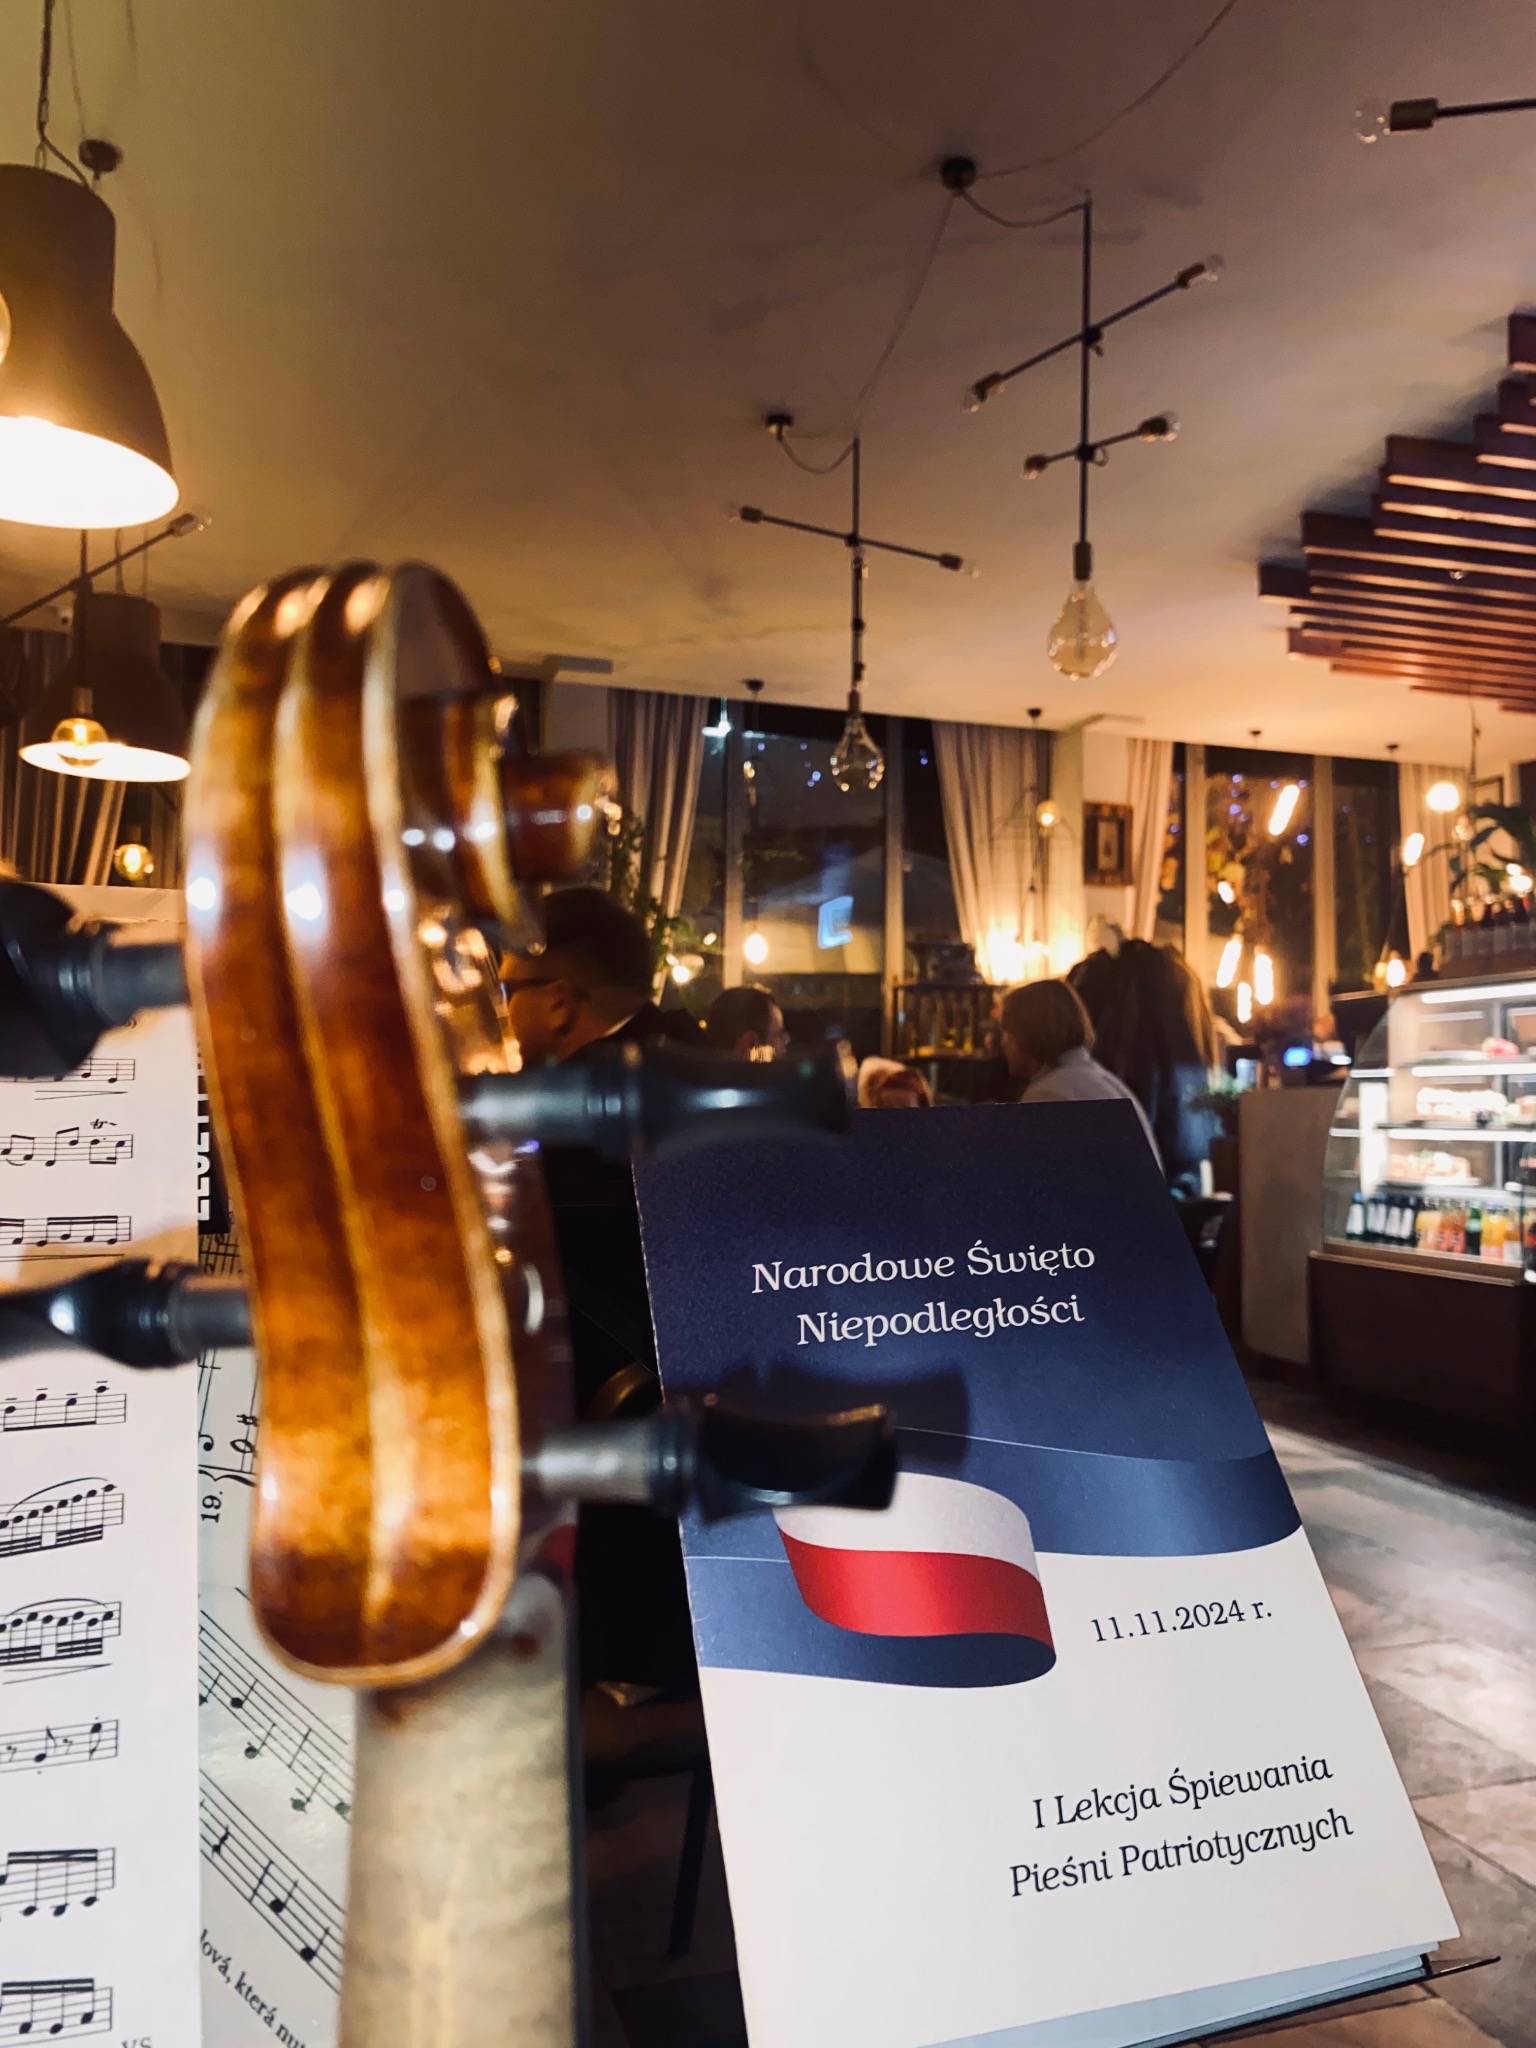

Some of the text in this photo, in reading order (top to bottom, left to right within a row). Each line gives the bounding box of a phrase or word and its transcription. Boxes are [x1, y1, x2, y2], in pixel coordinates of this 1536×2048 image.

[751, 1239, 1095, 1294] Narodowe Święto
[796, 1294, 1085, 1348] Niepodległości
[200, 1491, 223, 1523] 19.
[1090, 1599, 1272, 1642] 11.11.2024 r.
[1032, 1755, 1334, 1829] I Lekcja Śpiewania
[1009, 1807, 1354, 1897] Pieśni Patriotycznych
[234, 1972, 277, 2028] která
